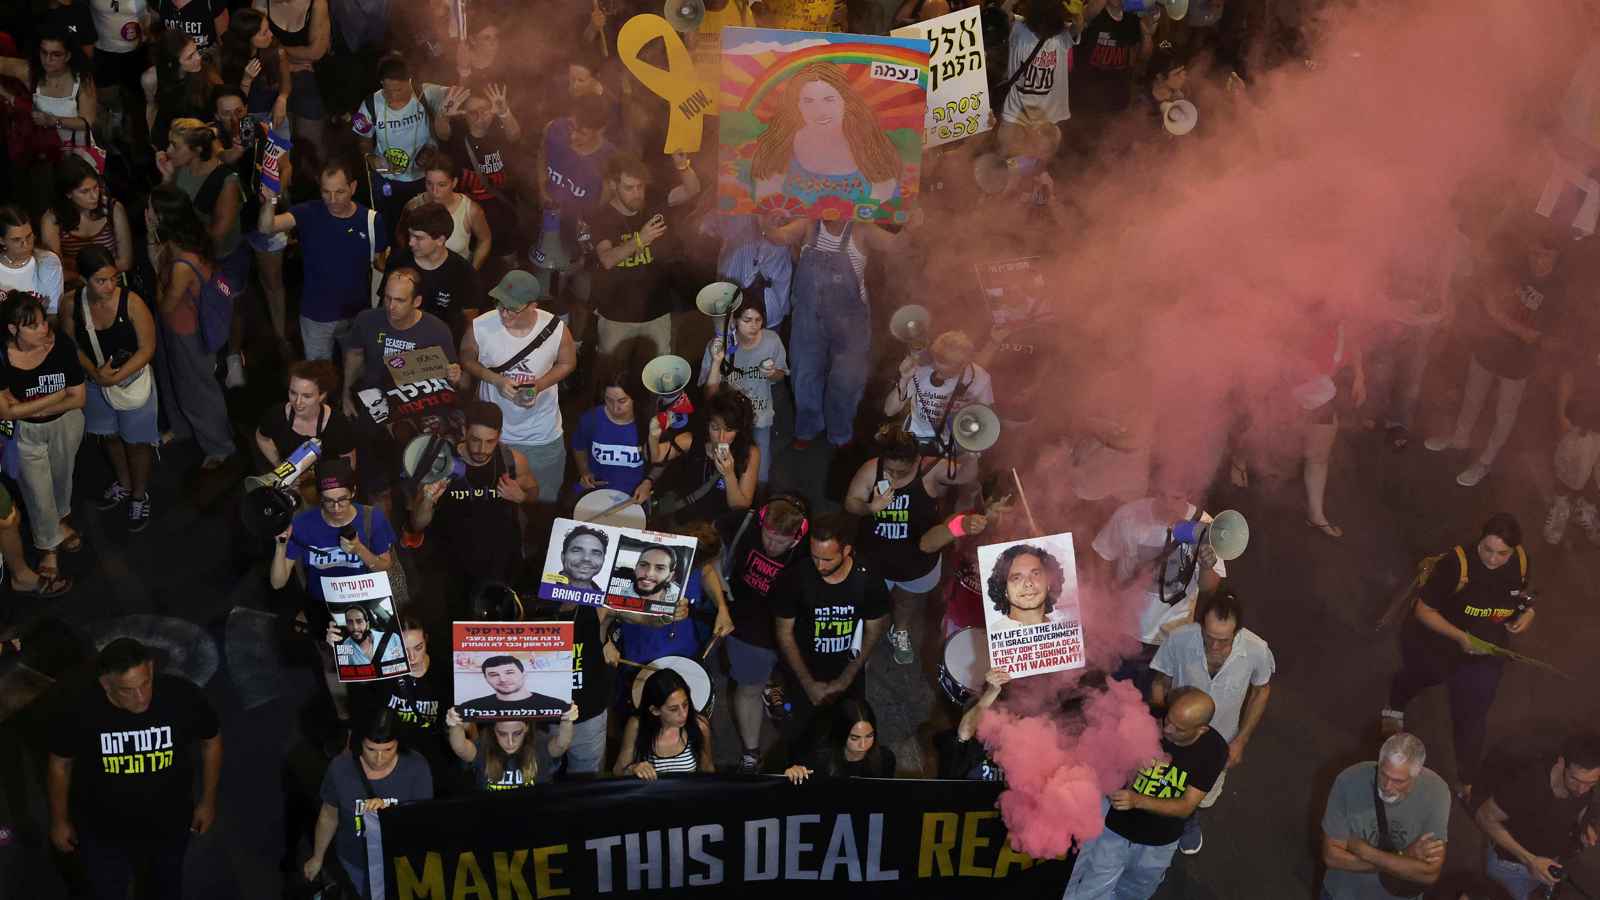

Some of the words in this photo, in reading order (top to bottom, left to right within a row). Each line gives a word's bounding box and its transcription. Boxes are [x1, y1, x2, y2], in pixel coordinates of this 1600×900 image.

[927, 17, 977, 59] אזל
[873, 65, 919, 81] נעמה
[929, 51, 982, 92] הזמן
[677, 88, 713, 120] NOW.
[932, 92, 984, 123] עסקה
[357, 578, 375, 591] מתן
[552, 587, 581, 602] BRING
[528, 627, 561, 635] איתי
[991, 632, 1003, 641] MY
[1004, 629, 1022, 639] LIFE
[1035, 624, 1051, 634] THE
[1052, 621, 1078, 631] HANDS
[1006, 636, 1033, 647] ISRAELI
[1033, 629, 1079, 642] GOVERNMENT
[994, 655, 1017, 666] THEY
[1017, 652, 1034, 662] ARE
[1035, 647, 1067, 659] SIGNING
[1068, 644, 1081, 654] MY
[1001, 647, 1018, 656] THEY
[1019, 644, 1038, 654] DON'T
[1039, 641, 1055, 650] SIGN
[1062, 637, 1081, 646] DEAL
[1029, 654, 1082, 670] WARRANT!
[464, 708, 497, 717] כבר?!
[499, 708, 537, 717] תלמדו
[540, 708, 562, 717] מתי
[100, 726, 173, 754] בלעדיהם
[102, 754, 145, 774] הבית!
[146, 750, 173, 772] הלך
[393, 844, 571, 900] MAKE
[585, 823, 724, 893] THIS
[743, 812, 900, 882] DEAL
[918, 810, 1067, 879] REA
